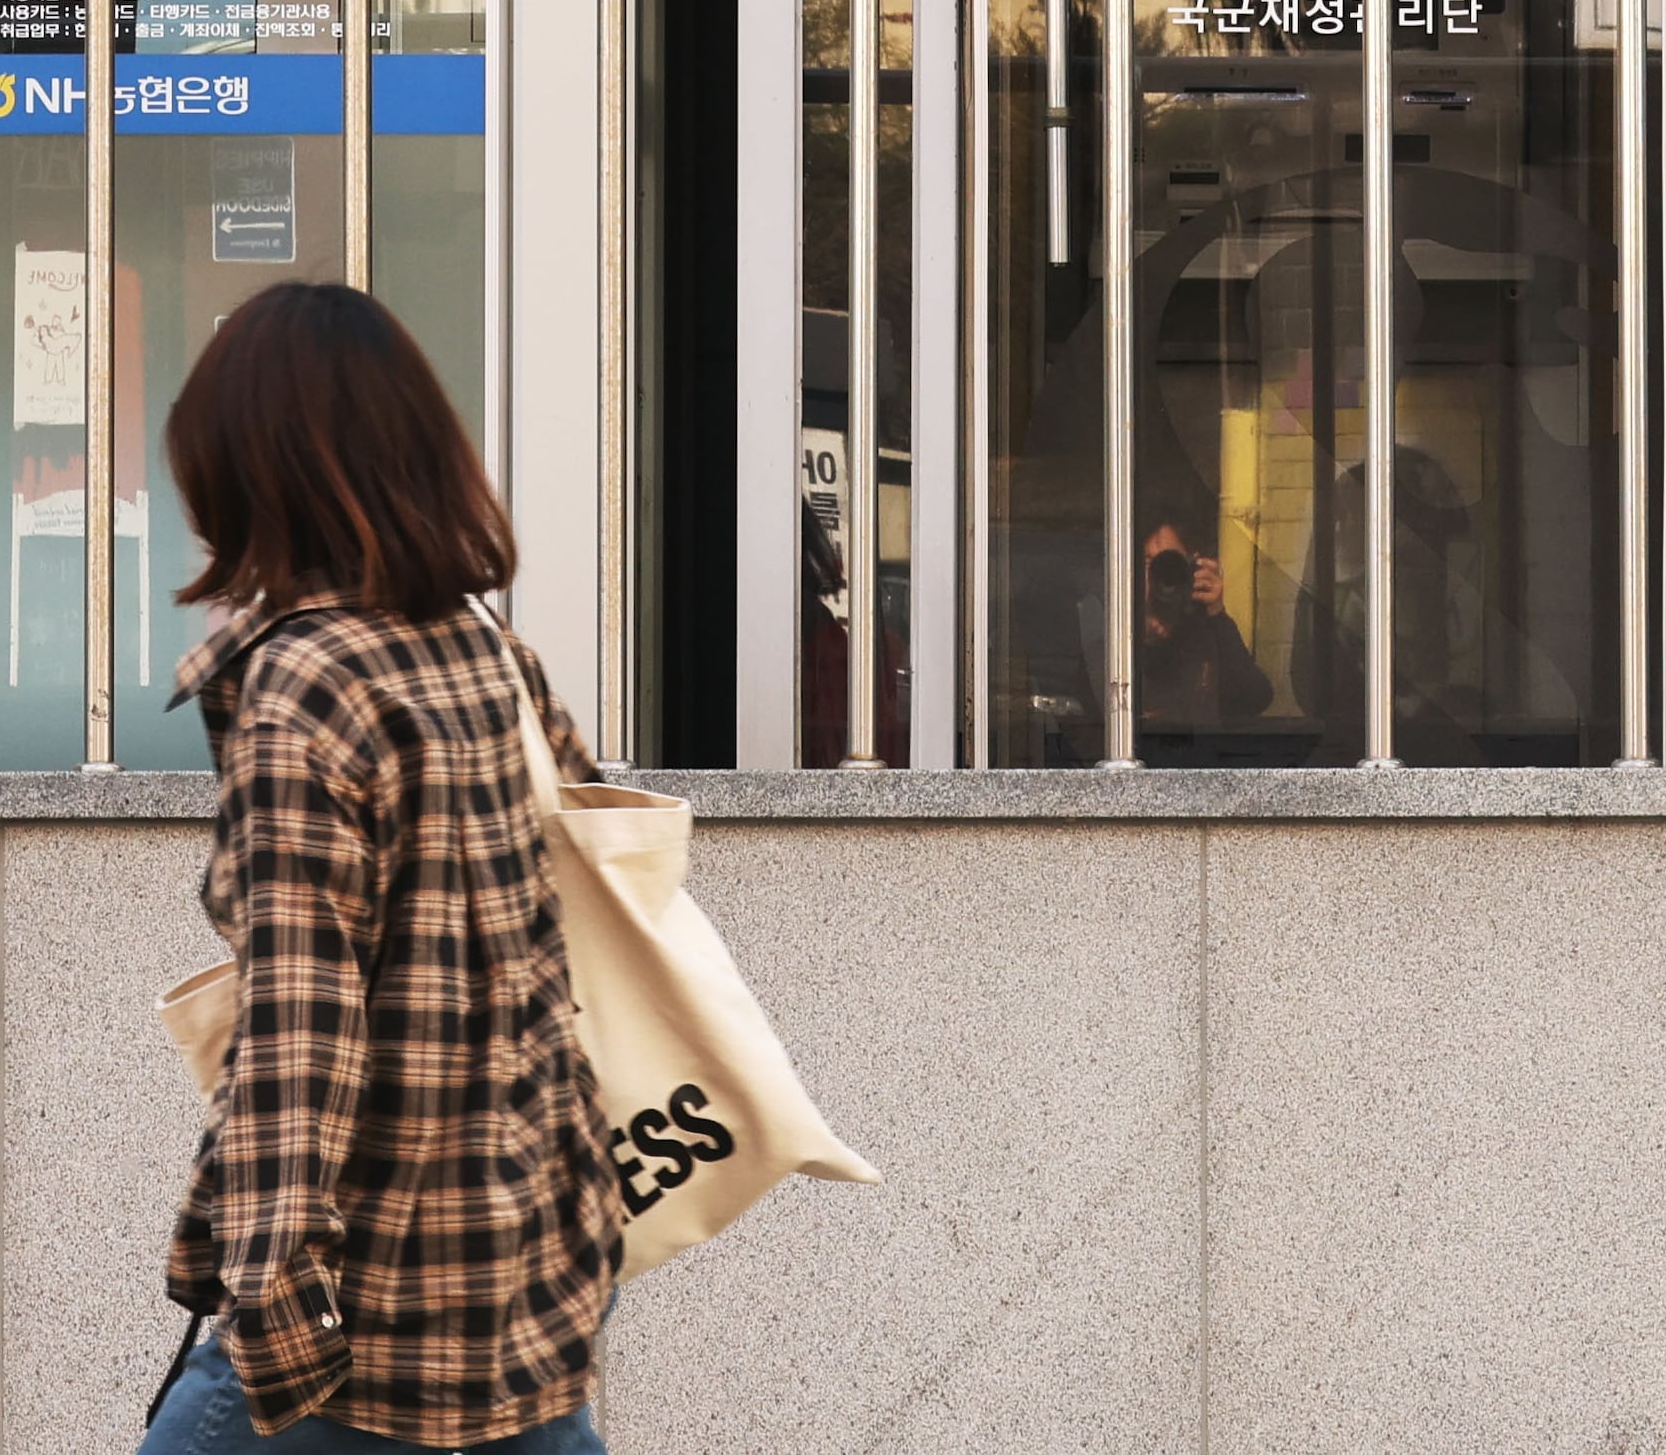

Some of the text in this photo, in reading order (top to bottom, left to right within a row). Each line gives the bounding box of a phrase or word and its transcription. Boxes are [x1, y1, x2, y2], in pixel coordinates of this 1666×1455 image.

[0, 4, 60, 19] 사용카드
[150, 4, 210, 19] 타행카드
[225, 4, 330, 19] 전금융기관사용
[0, 23, 60, 38] 취급업무
[135, 23, 164, 37] 출금
[180, 23, 240, 38] 계좌이체
